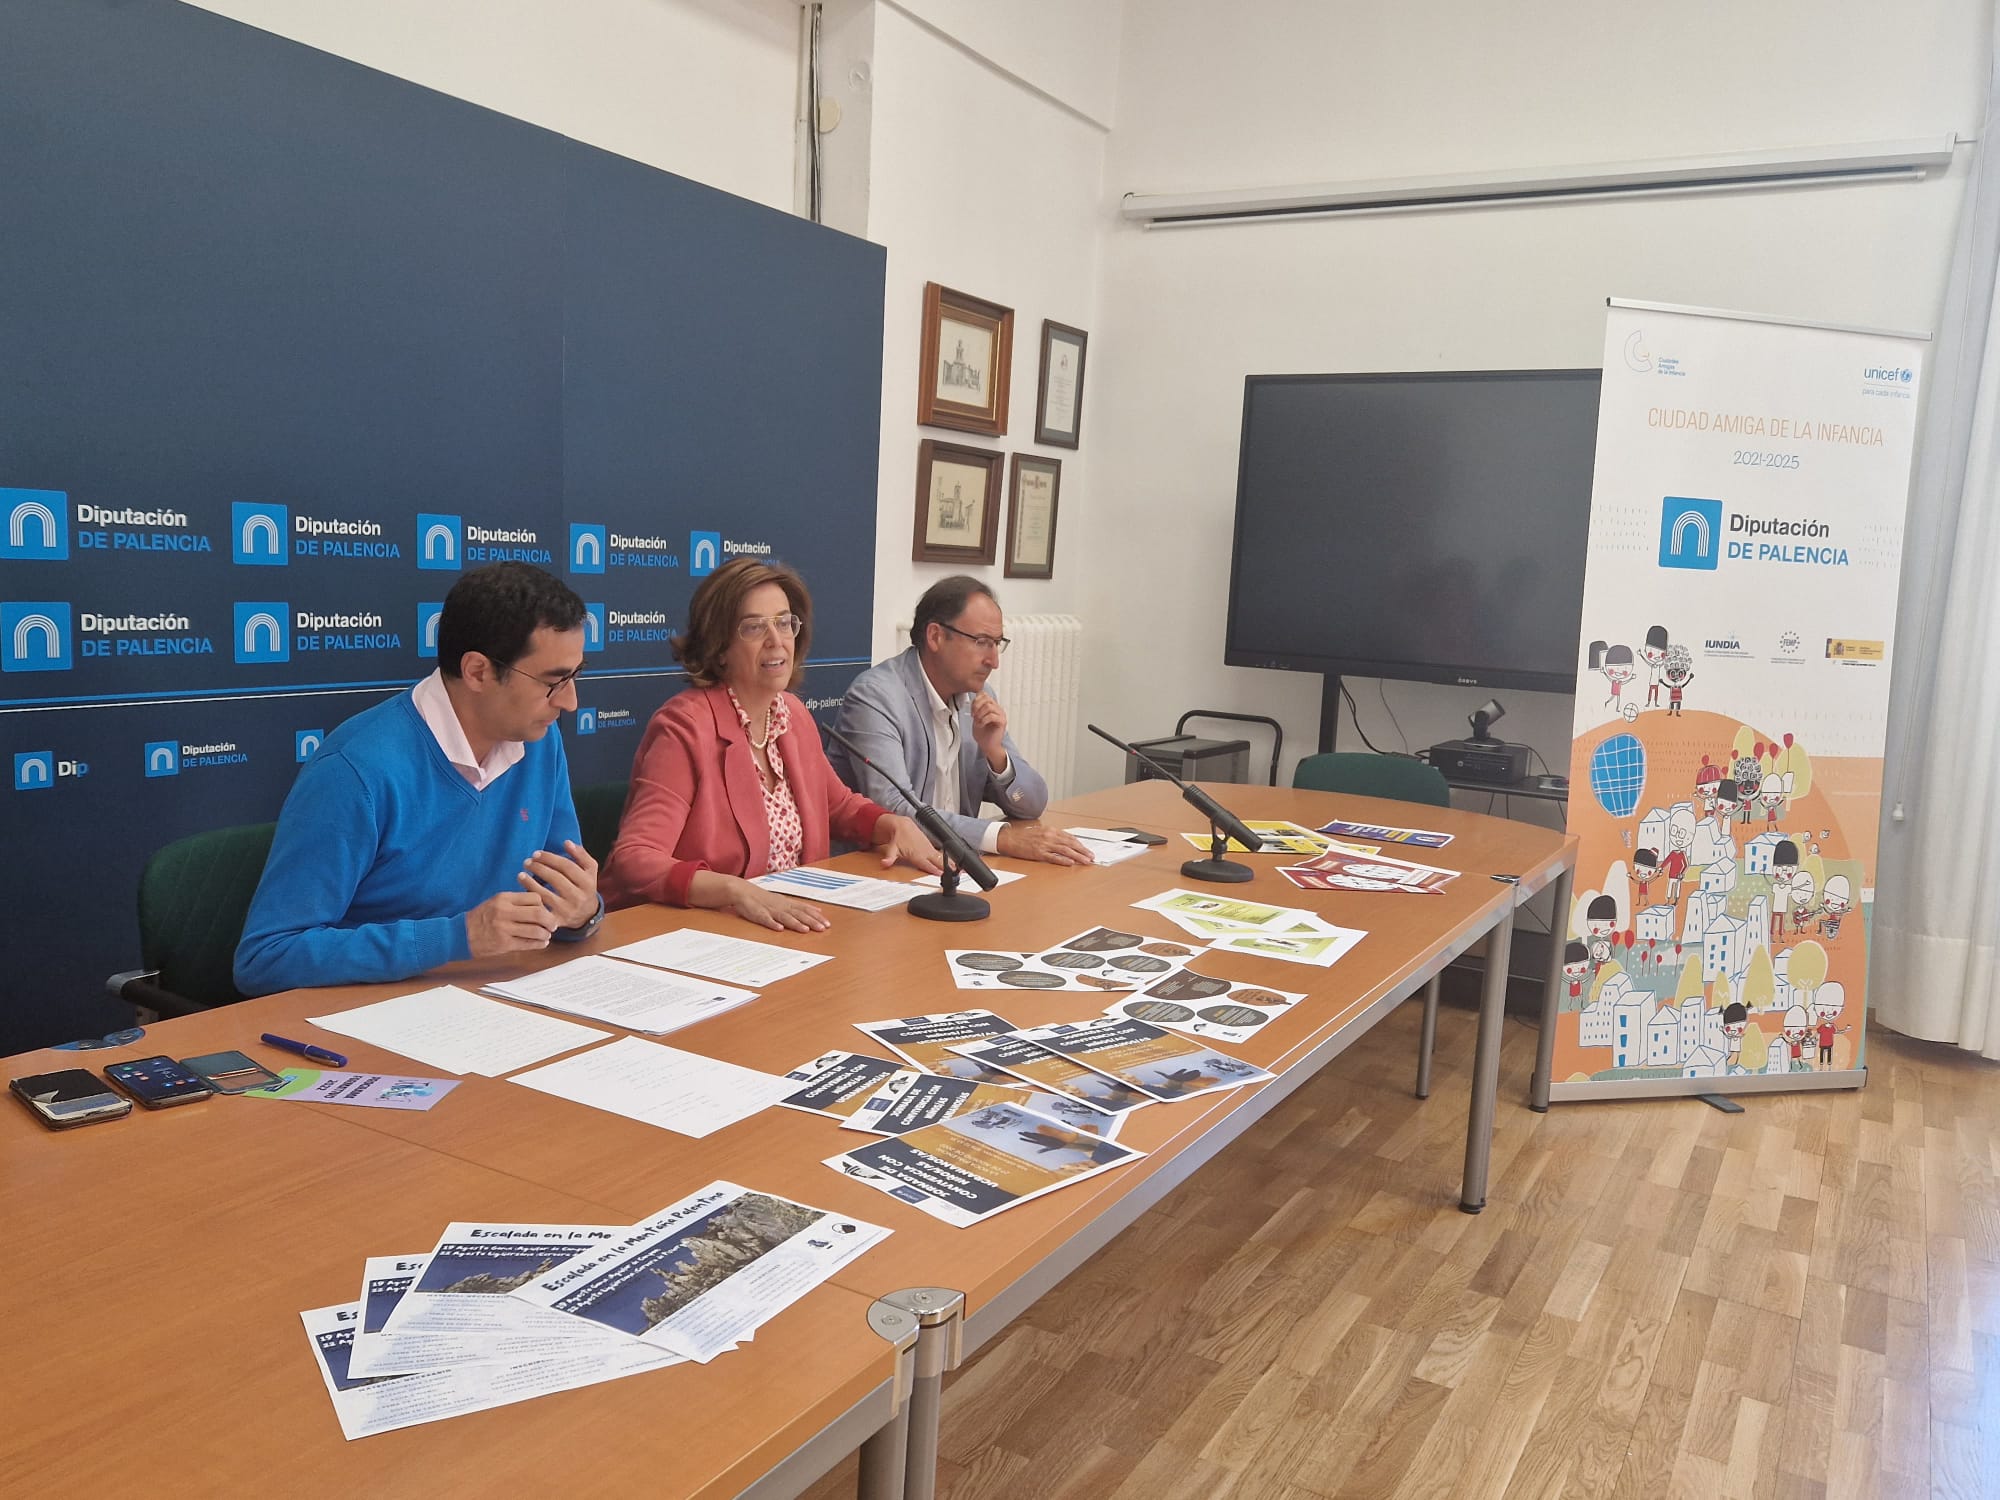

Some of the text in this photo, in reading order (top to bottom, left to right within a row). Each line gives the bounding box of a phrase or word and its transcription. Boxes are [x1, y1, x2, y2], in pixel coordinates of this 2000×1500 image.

[1863, 366, 1900, 382] unicef
[1648, 407, 1884, 447] CIUDAD AMIGA DE LA INFANCIA
[1733, 450, 1800, 470] 2021-2025
[77, 504, 187, 528] Diputación
[295, 516, 381, 537] Diputación
[1729, 513, 1830, 538] Diputación
[79, 531, 211, 552] DE PALENCIA
[467, 526, 537, 544] Diputación
[610, 534, 667, 551] Diputación
[296, 540, 400, 559] DE PALENCIA
[467, 547, 552, 563] DE PALENCIA
[723, 540, 772, 556] Diputación
[1727, 542, 1849, 566] DE PALENCIA
[610, 553, 679, 568] DE PALENCIA
[81, 613, 189, 634] Diputación
[297, 612, 382, 631] Diputación
[609, 611, 666, 628] Diputación
[297, 634, 401, 651] DE PALENCIA
[609, 629, 625, 642] DE
[1704, 639, 1740, 650] IUNDIA
[82, 638, 213, 657] DE PALENCIA
[598, 709, 630, 720] Diputación
[182, 742, 236, 756] Diputación
[58, 760, 89, 777] Dip
[183, 754, 247, 769] DE PALENCIA
[805, 1063, 869, 1099] CONVIVENCIA CON
[891, 1094, 915, 1118] JORNADA
[900, 1084, 943, 1126] CONVIVENCIA CON
[877, 1154, 904, 1169] CON
[878, 1165, 897, 1178] DE
[897, 1170, 951, 1199] JORNADA
[903, 1163, 979, 1200] CONVIVENCIA
[470, 1229, 538, 1239] Escalada
[567, 1231, 582, 1239] la
[542, 1191, 724, 1291] Escalada en la Montaña Palentina
[319, 1334, 333, 1342] 19
